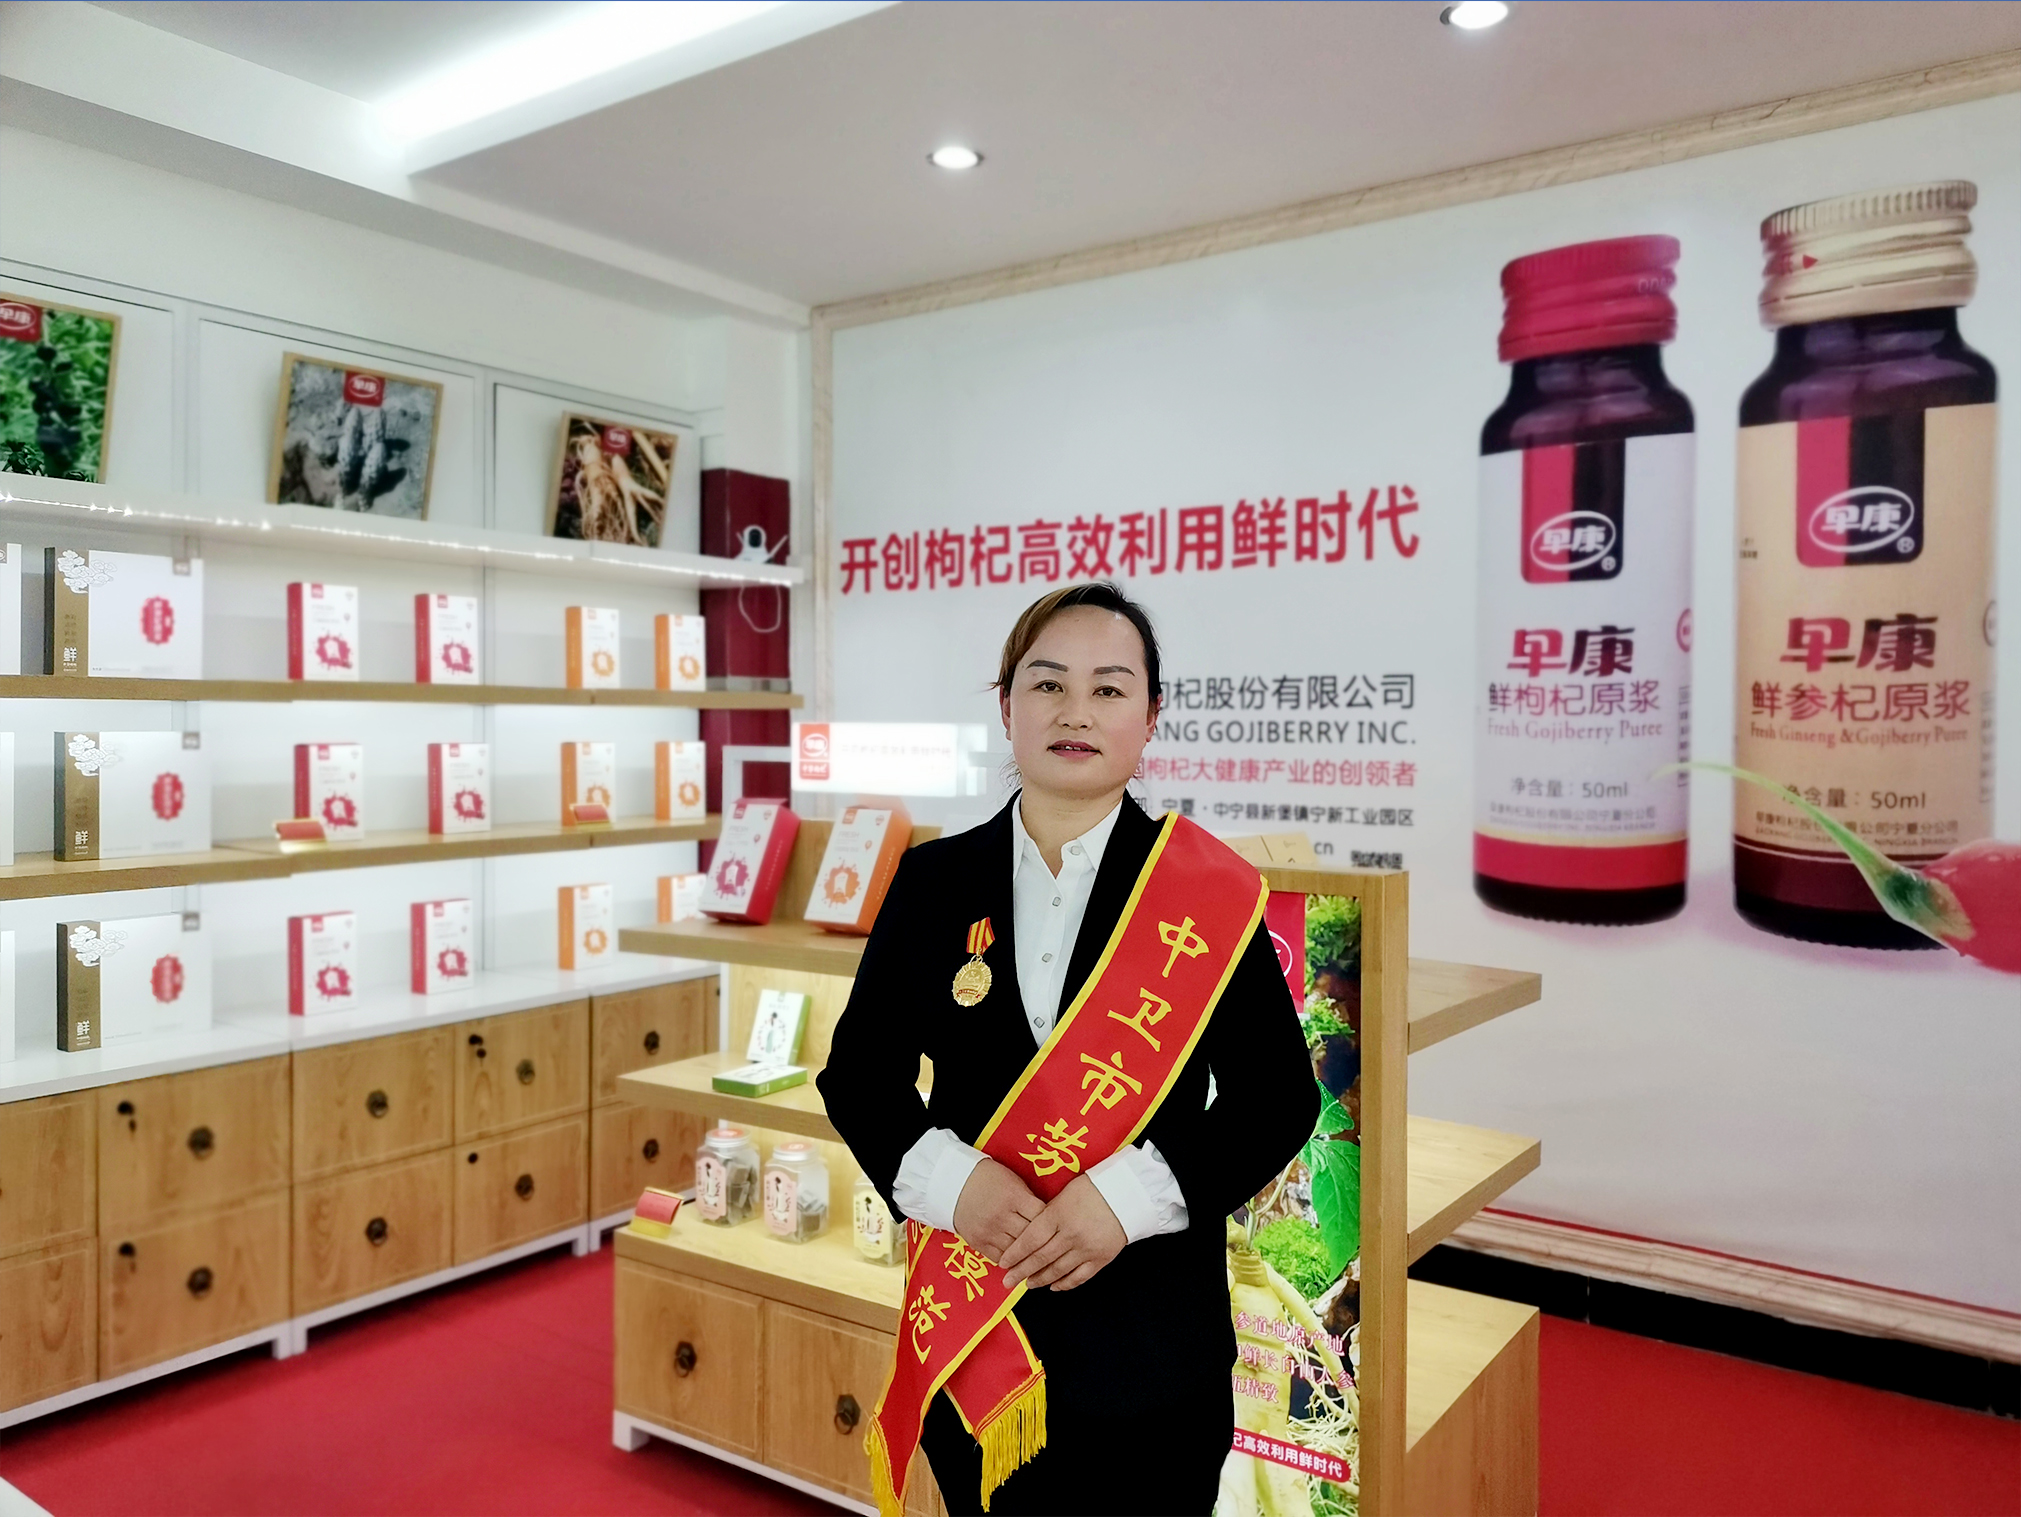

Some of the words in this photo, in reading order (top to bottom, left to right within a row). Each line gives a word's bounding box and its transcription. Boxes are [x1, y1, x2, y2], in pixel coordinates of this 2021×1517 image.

[1821, 503, 1901, 534] 早康
[840, 485, 1420, 595] 开创枸杞高效利用鲜时代
[1540, 525, 1606, 554] 早康
[1507, 625, 1635, 678] 早康
[1779, 613, 1938, 672] 早康
[1488, 680, 1661, 717] 鲜枸杞原浆
[1750, 680, 1971, 722] 鲜参杞原浆
[1207, 720, 1349, 744] GOJIBERRY
[1358, 721, 1416, 744] INC.
[1488, 717, 1519, 737] Fresh
[1525, 718, 1614, 745] Gojiberry
[1620, 719, 1663, 738] Puree
[1751, 722, 1776, 738] Fresh
[1780, 725, 1836, 748] Ginseng
[1581, 781, 1628, 798] 50ml
[1870, 791, 1926, 809] 50ml
[1313, 840, 1334, 856] cn
[1235, 1311, 1345, 1356] 参道地原产地
